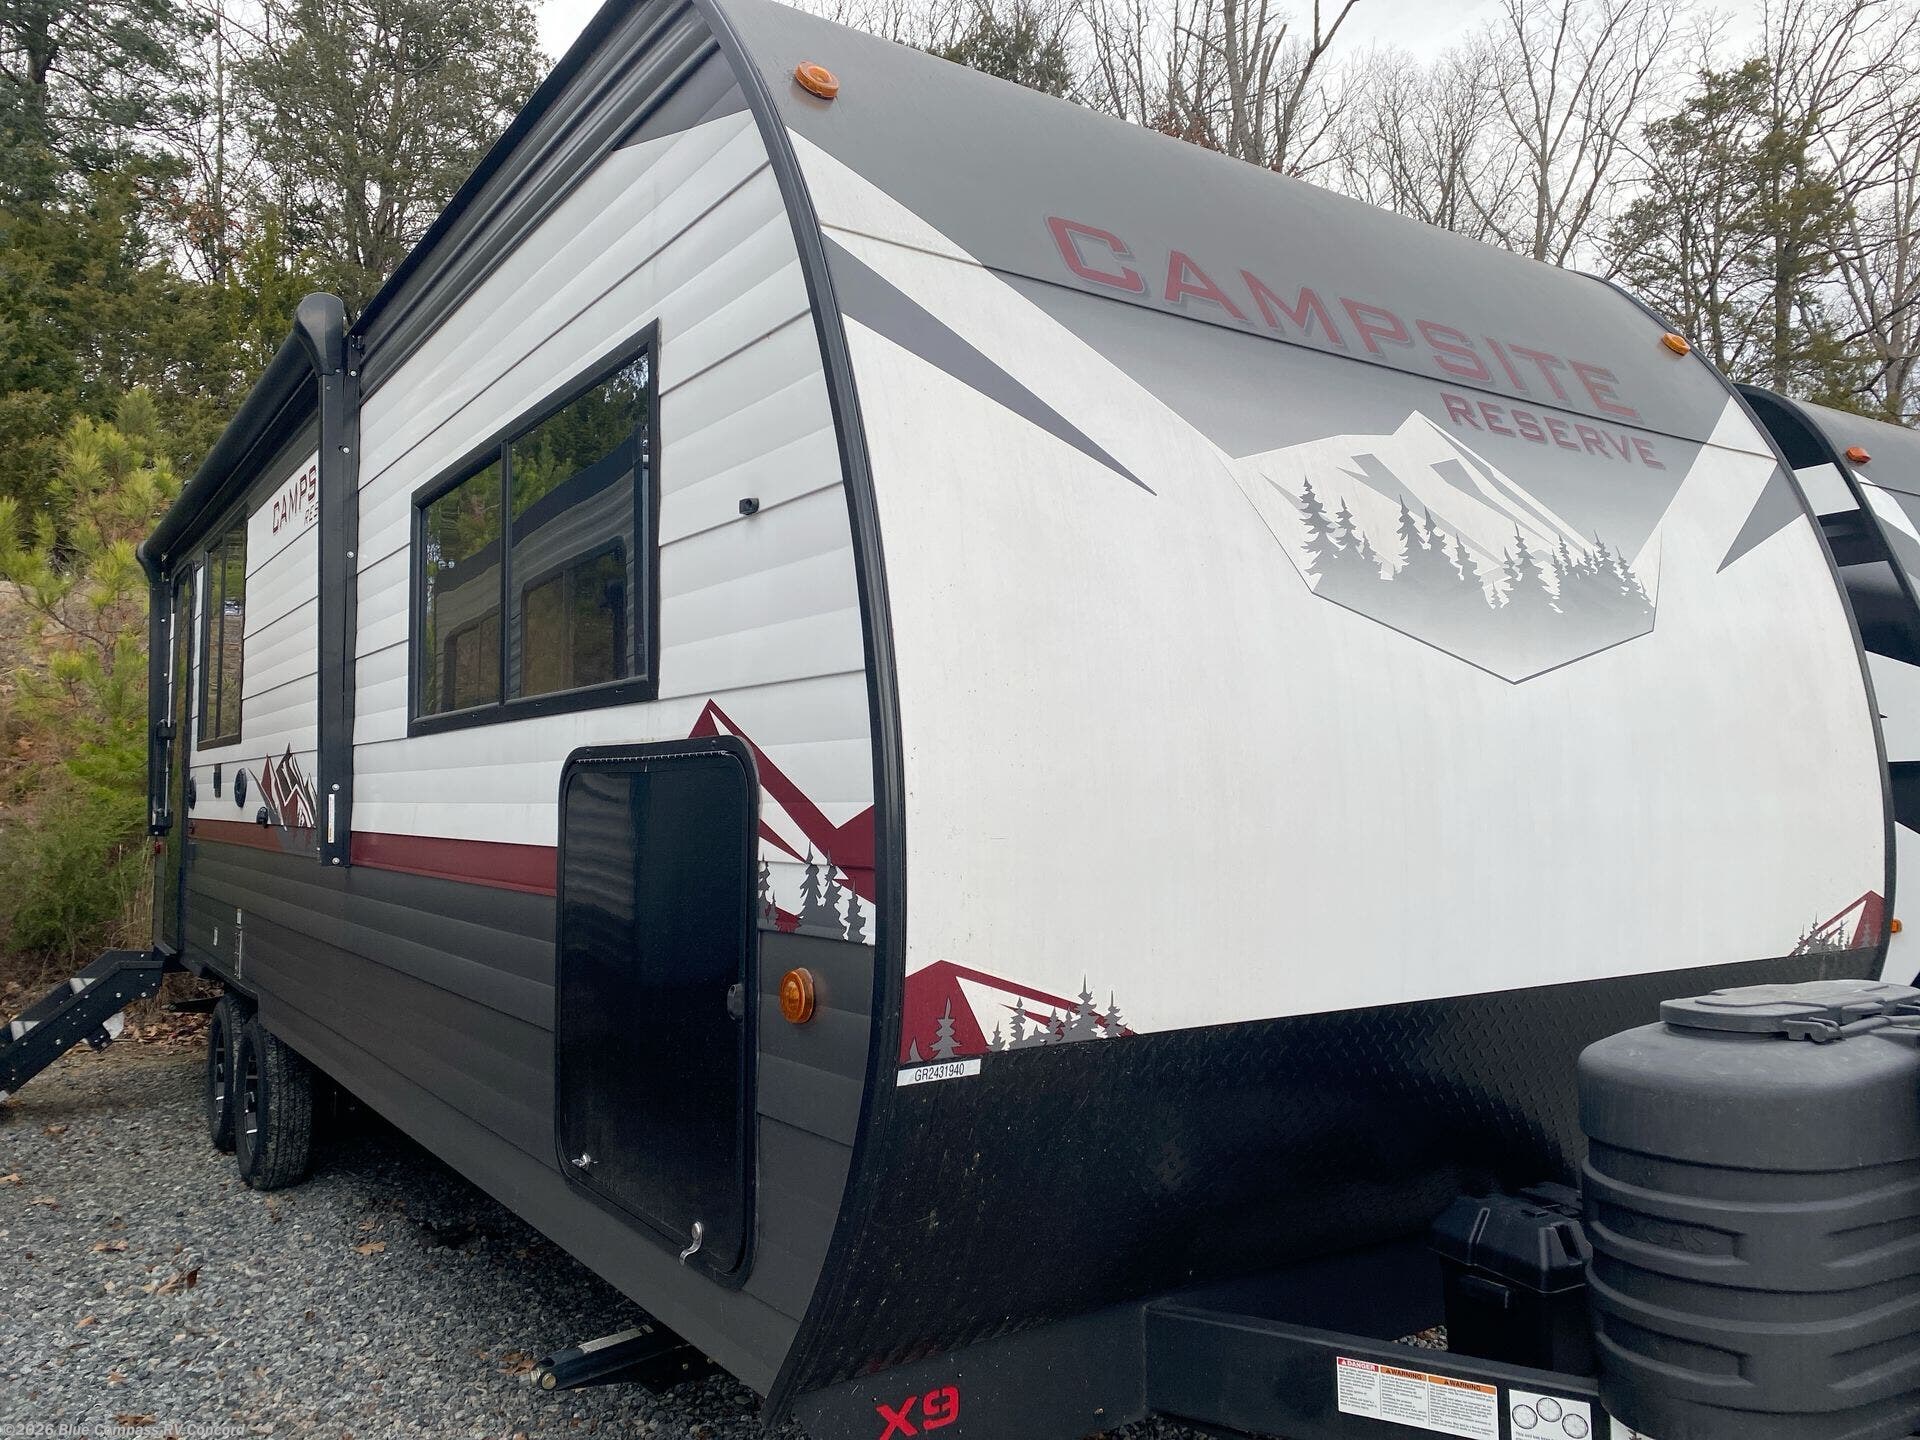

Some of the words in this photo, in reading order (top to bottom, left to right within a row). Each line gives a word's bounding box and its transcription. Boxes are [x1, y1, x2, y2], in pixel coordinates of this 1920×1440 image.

[1044, 214, 1643, 420] CAMPSITE
[1440, 391, 1667, 470] RESERVE
[272, 465, 317, 534] CAMPS
[914, 1062, 965, 1082] GR2431940
[1347, 1360, 1376, 1371] DANGER
[1391, 1368, 1422, 1380] WARNING
[1449, 1380, 1481, 1391] WARNING
[875, 1385, 959, 1440] X9
